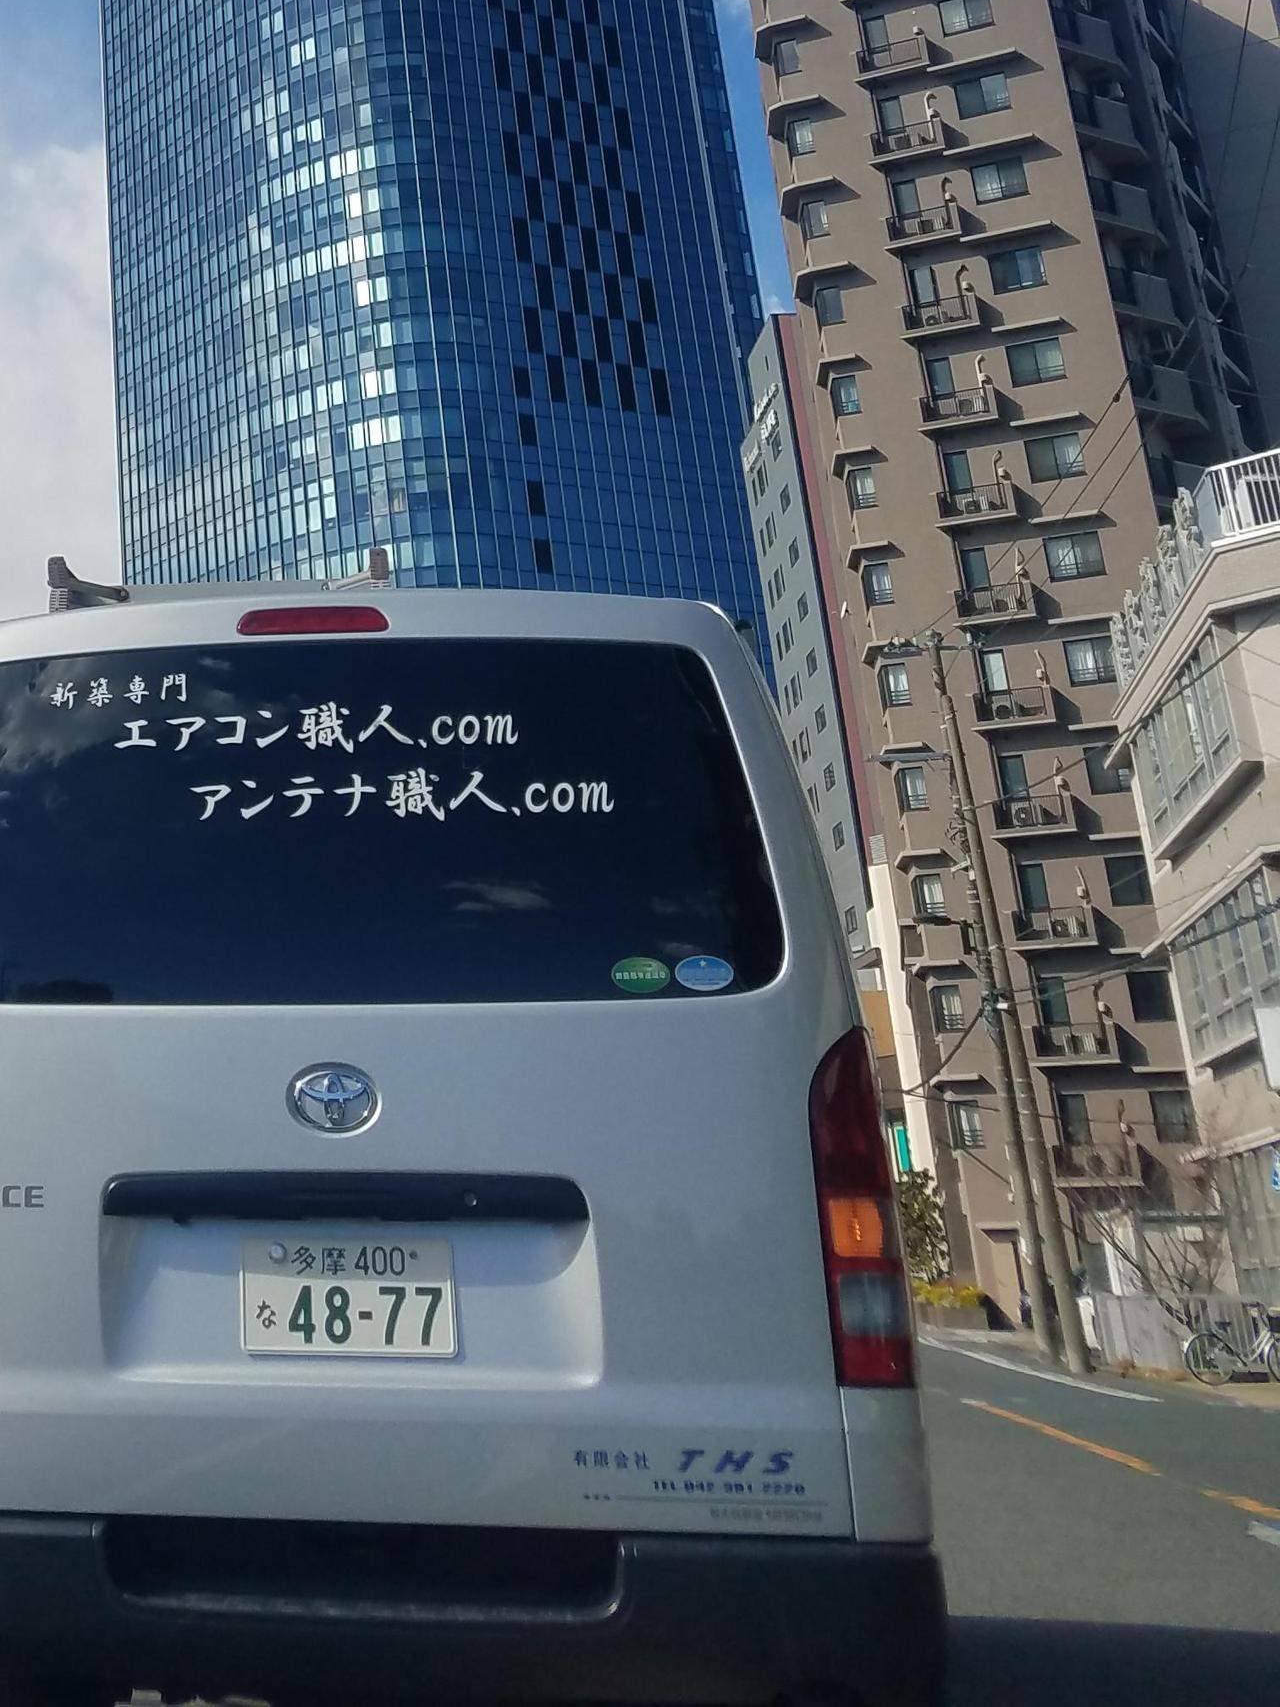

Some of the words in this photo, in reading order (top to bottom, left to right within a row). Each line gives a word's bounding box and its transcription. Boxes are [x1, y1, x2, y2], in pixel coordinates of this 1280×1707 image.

[49, 673, 188, 710] 新築専門
[113, 700, 520, 754] エアコン職人.com
[189, 767, 615, 822] アンテナ職人.com
[290, 1245, 347, 1276] 多摩
[353, 1246, 407, 1276] 400
[255, 1299, 277, 1330] な
[288, 1285, 443, 1347] 48-77
[573, 1449, 651, 1471] 有限会社
